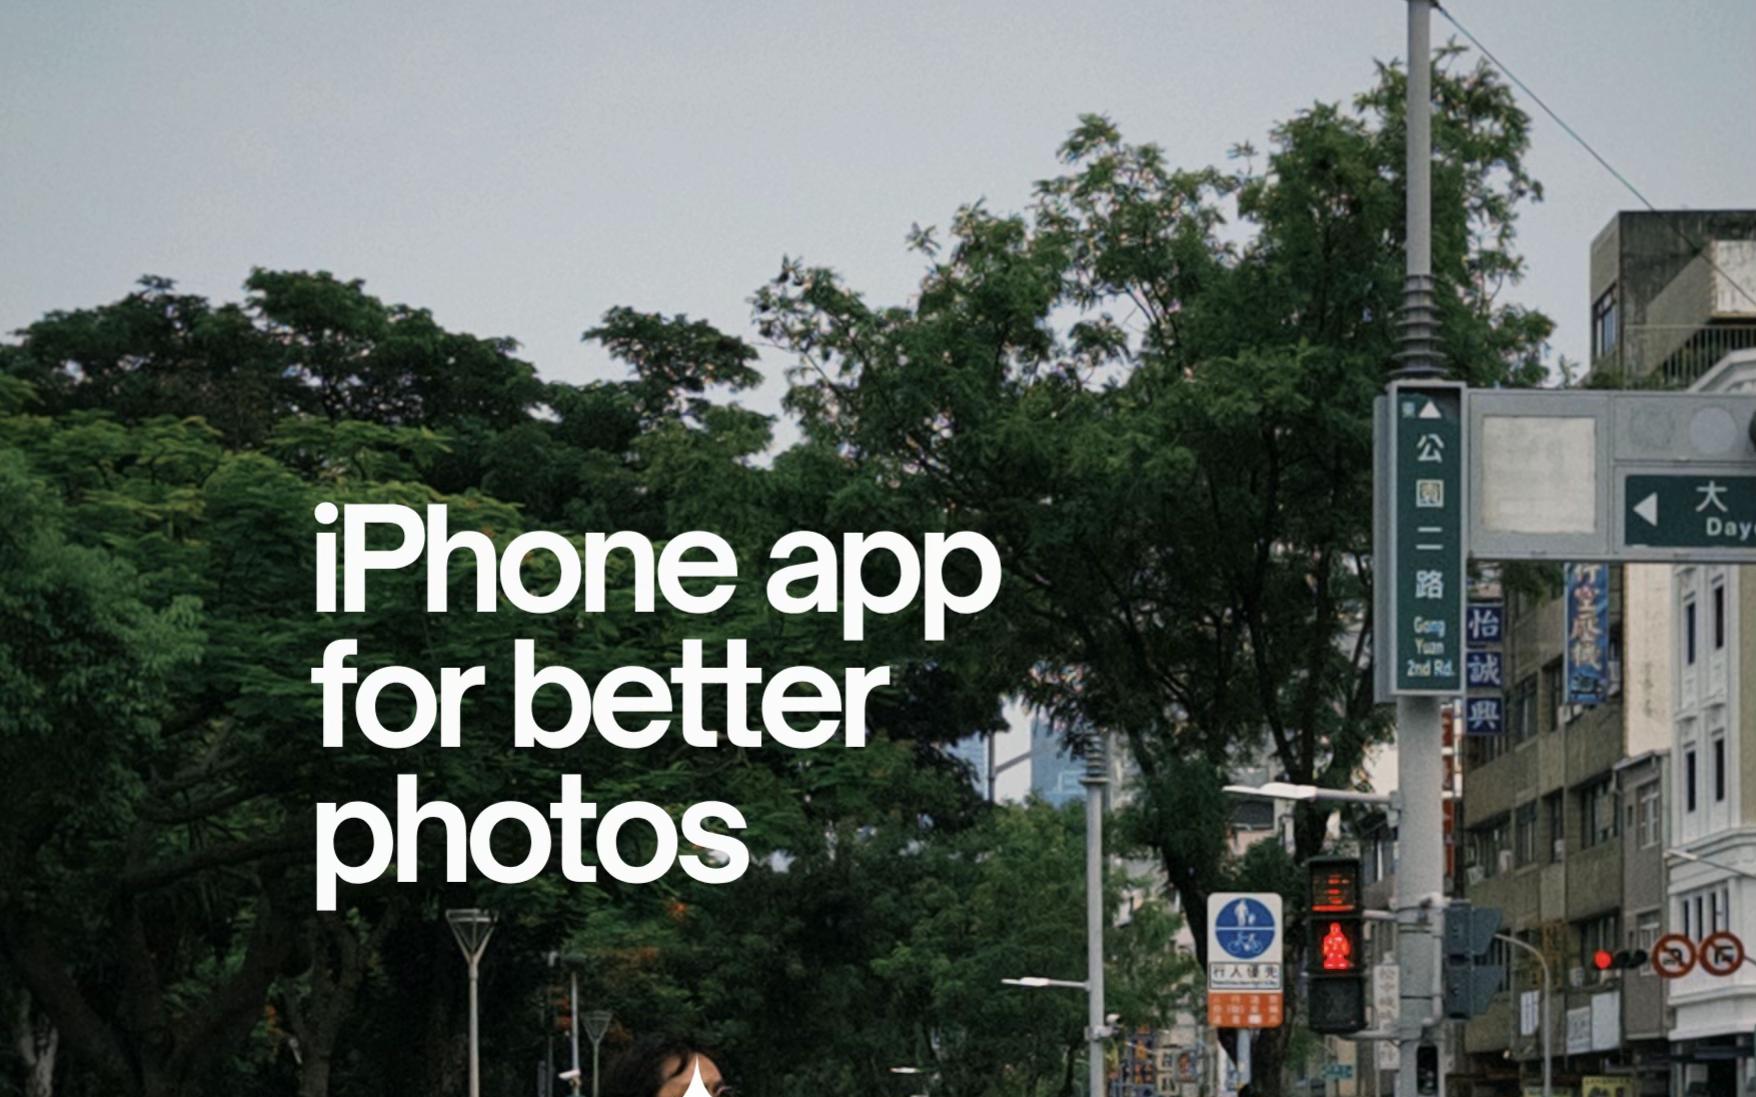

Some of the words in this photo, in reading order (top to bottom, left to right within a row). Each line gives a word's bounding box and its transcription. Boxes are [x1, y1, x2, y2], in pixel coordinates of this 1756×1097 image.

[1696, 480, 1728, 512] 大
[1415, 433, 1445, 599] 公園二路
[1706, 516, 1756, 541] Day
[1413, 616, 1446, 638] Gong
[1406, 659, 1432, 677] 2nd
